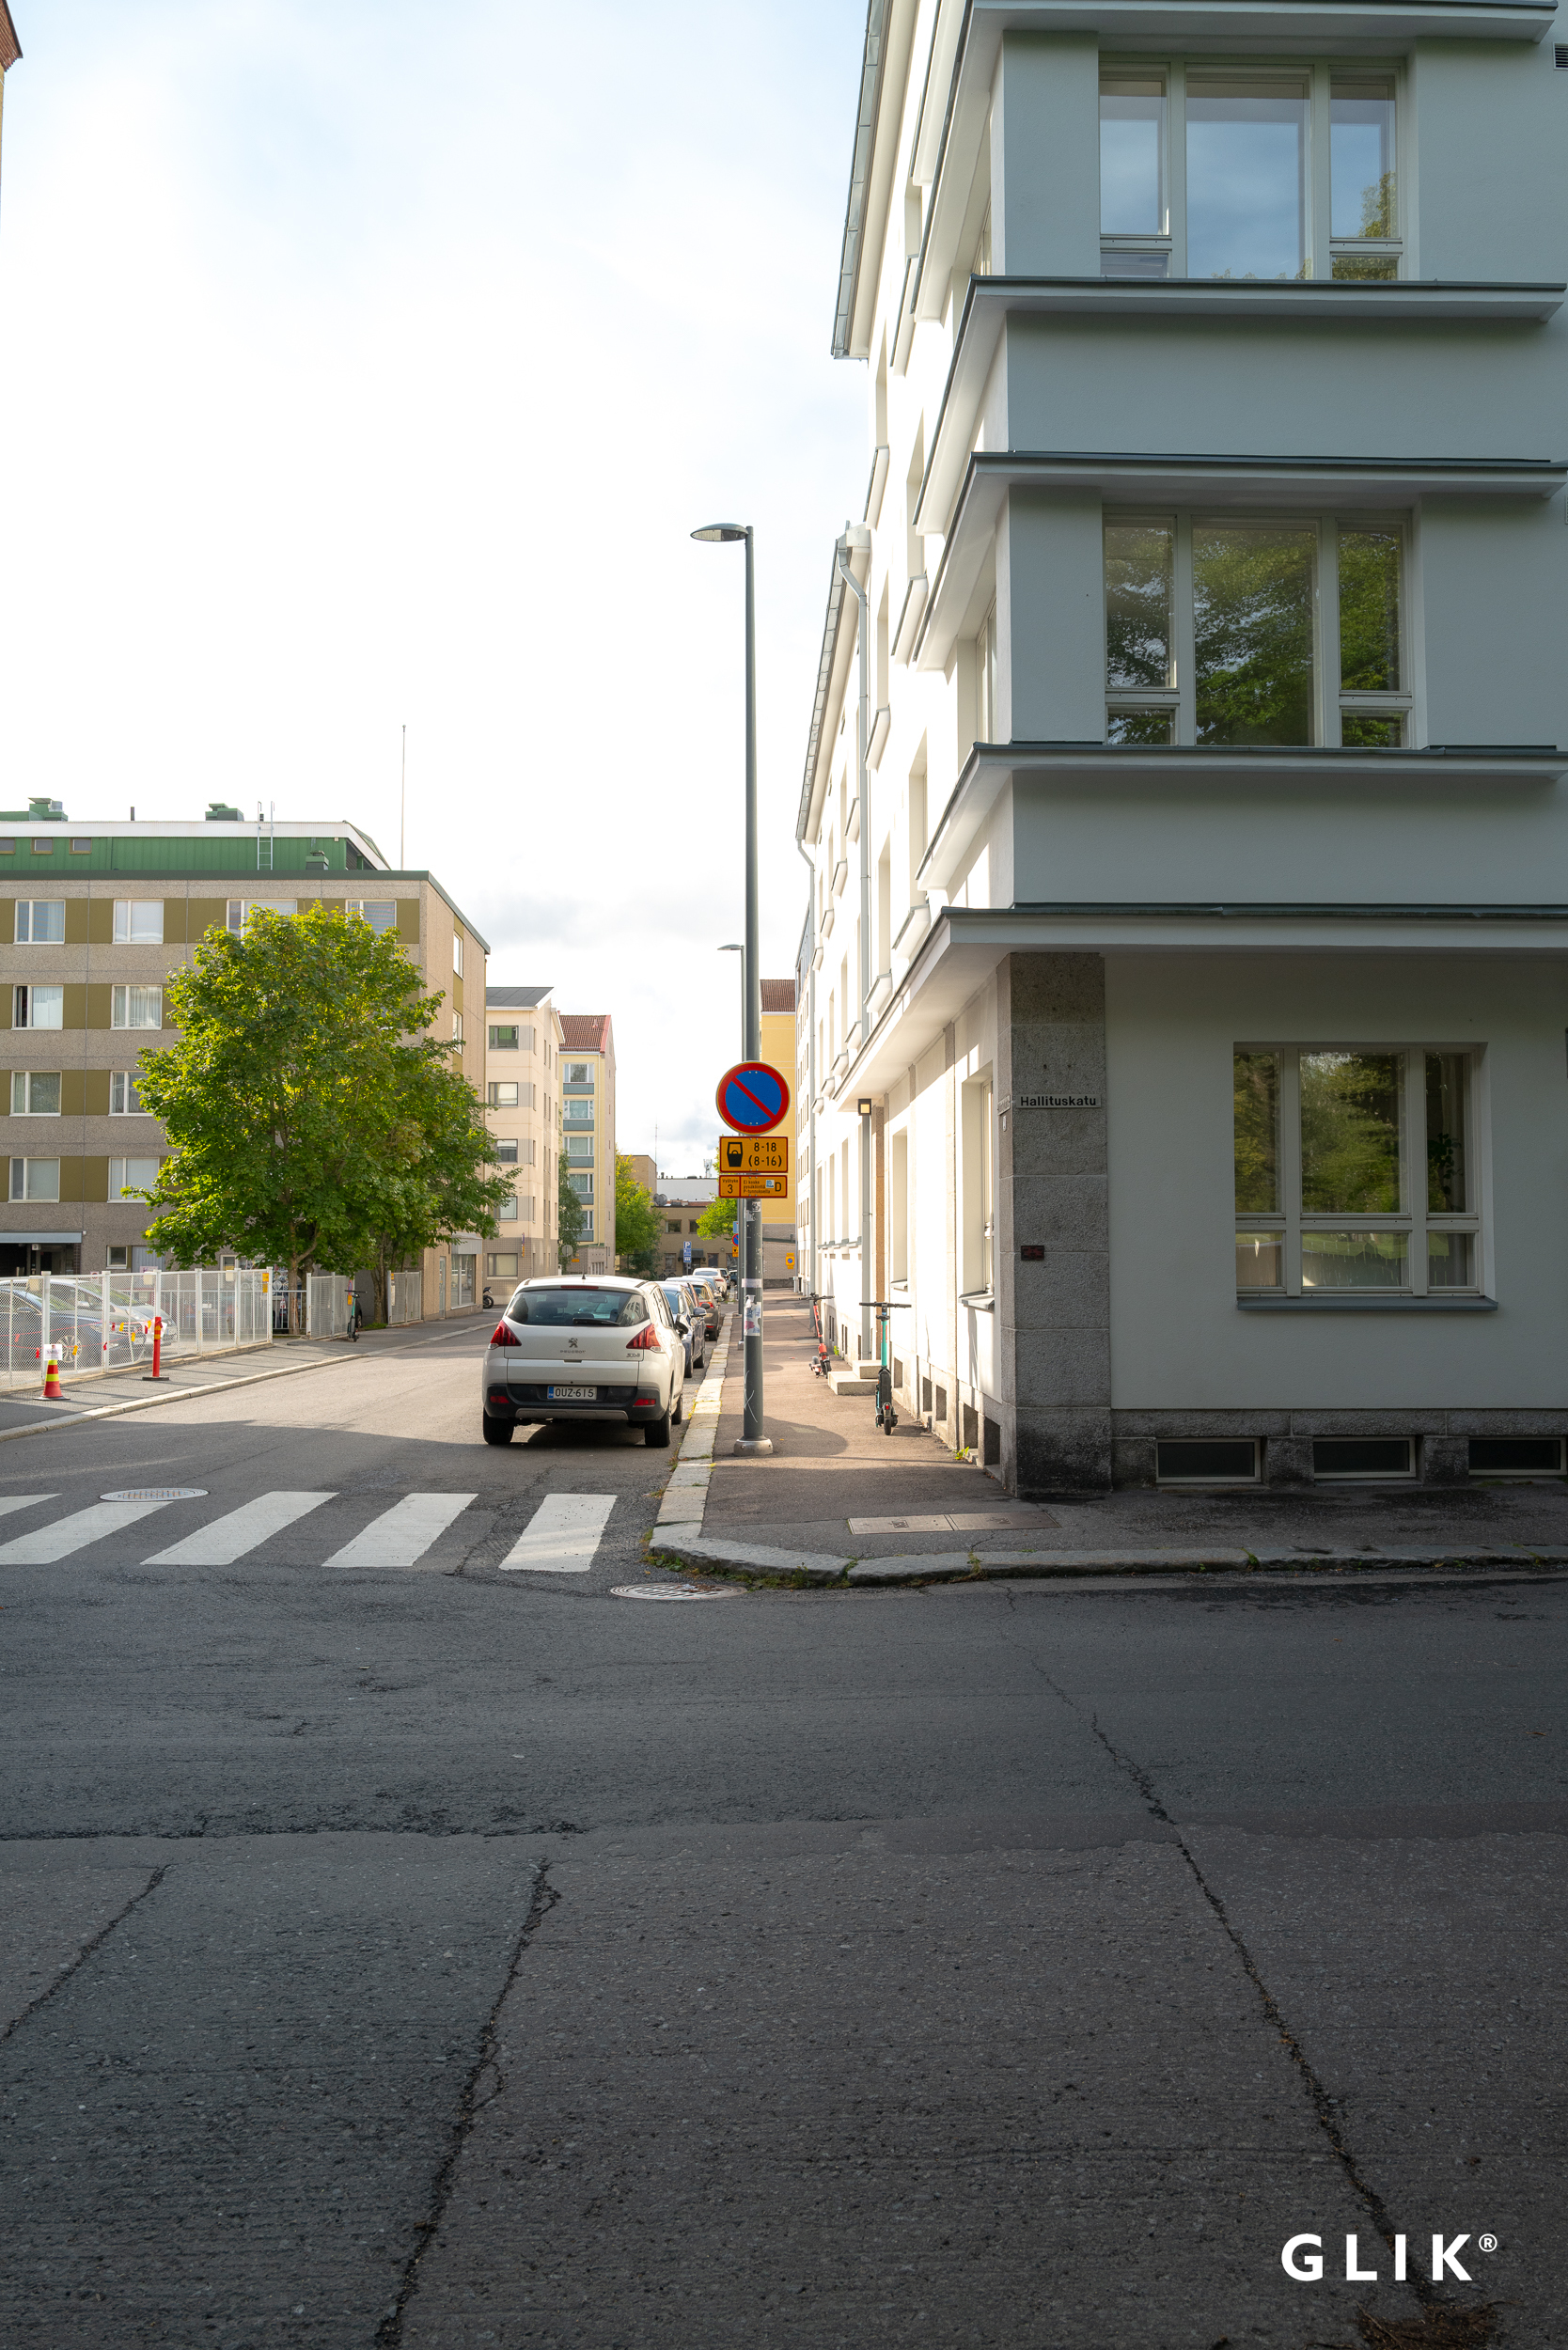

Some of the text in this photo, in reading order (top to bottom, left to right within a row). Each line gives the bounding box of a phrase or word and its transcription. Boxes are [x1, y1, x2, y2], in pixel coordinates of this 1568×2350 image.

[1020, 1095, 1096, 1106] Hallituskatu
[754, 1142, 776, 1152] 8-18
[748, 1154, 782, 1167] (8-16)
[727, 1183, 733, 1194] 3
[775, 1182, 781, 1192] D
[555, 1387, 594, 1398] OUZ-615
